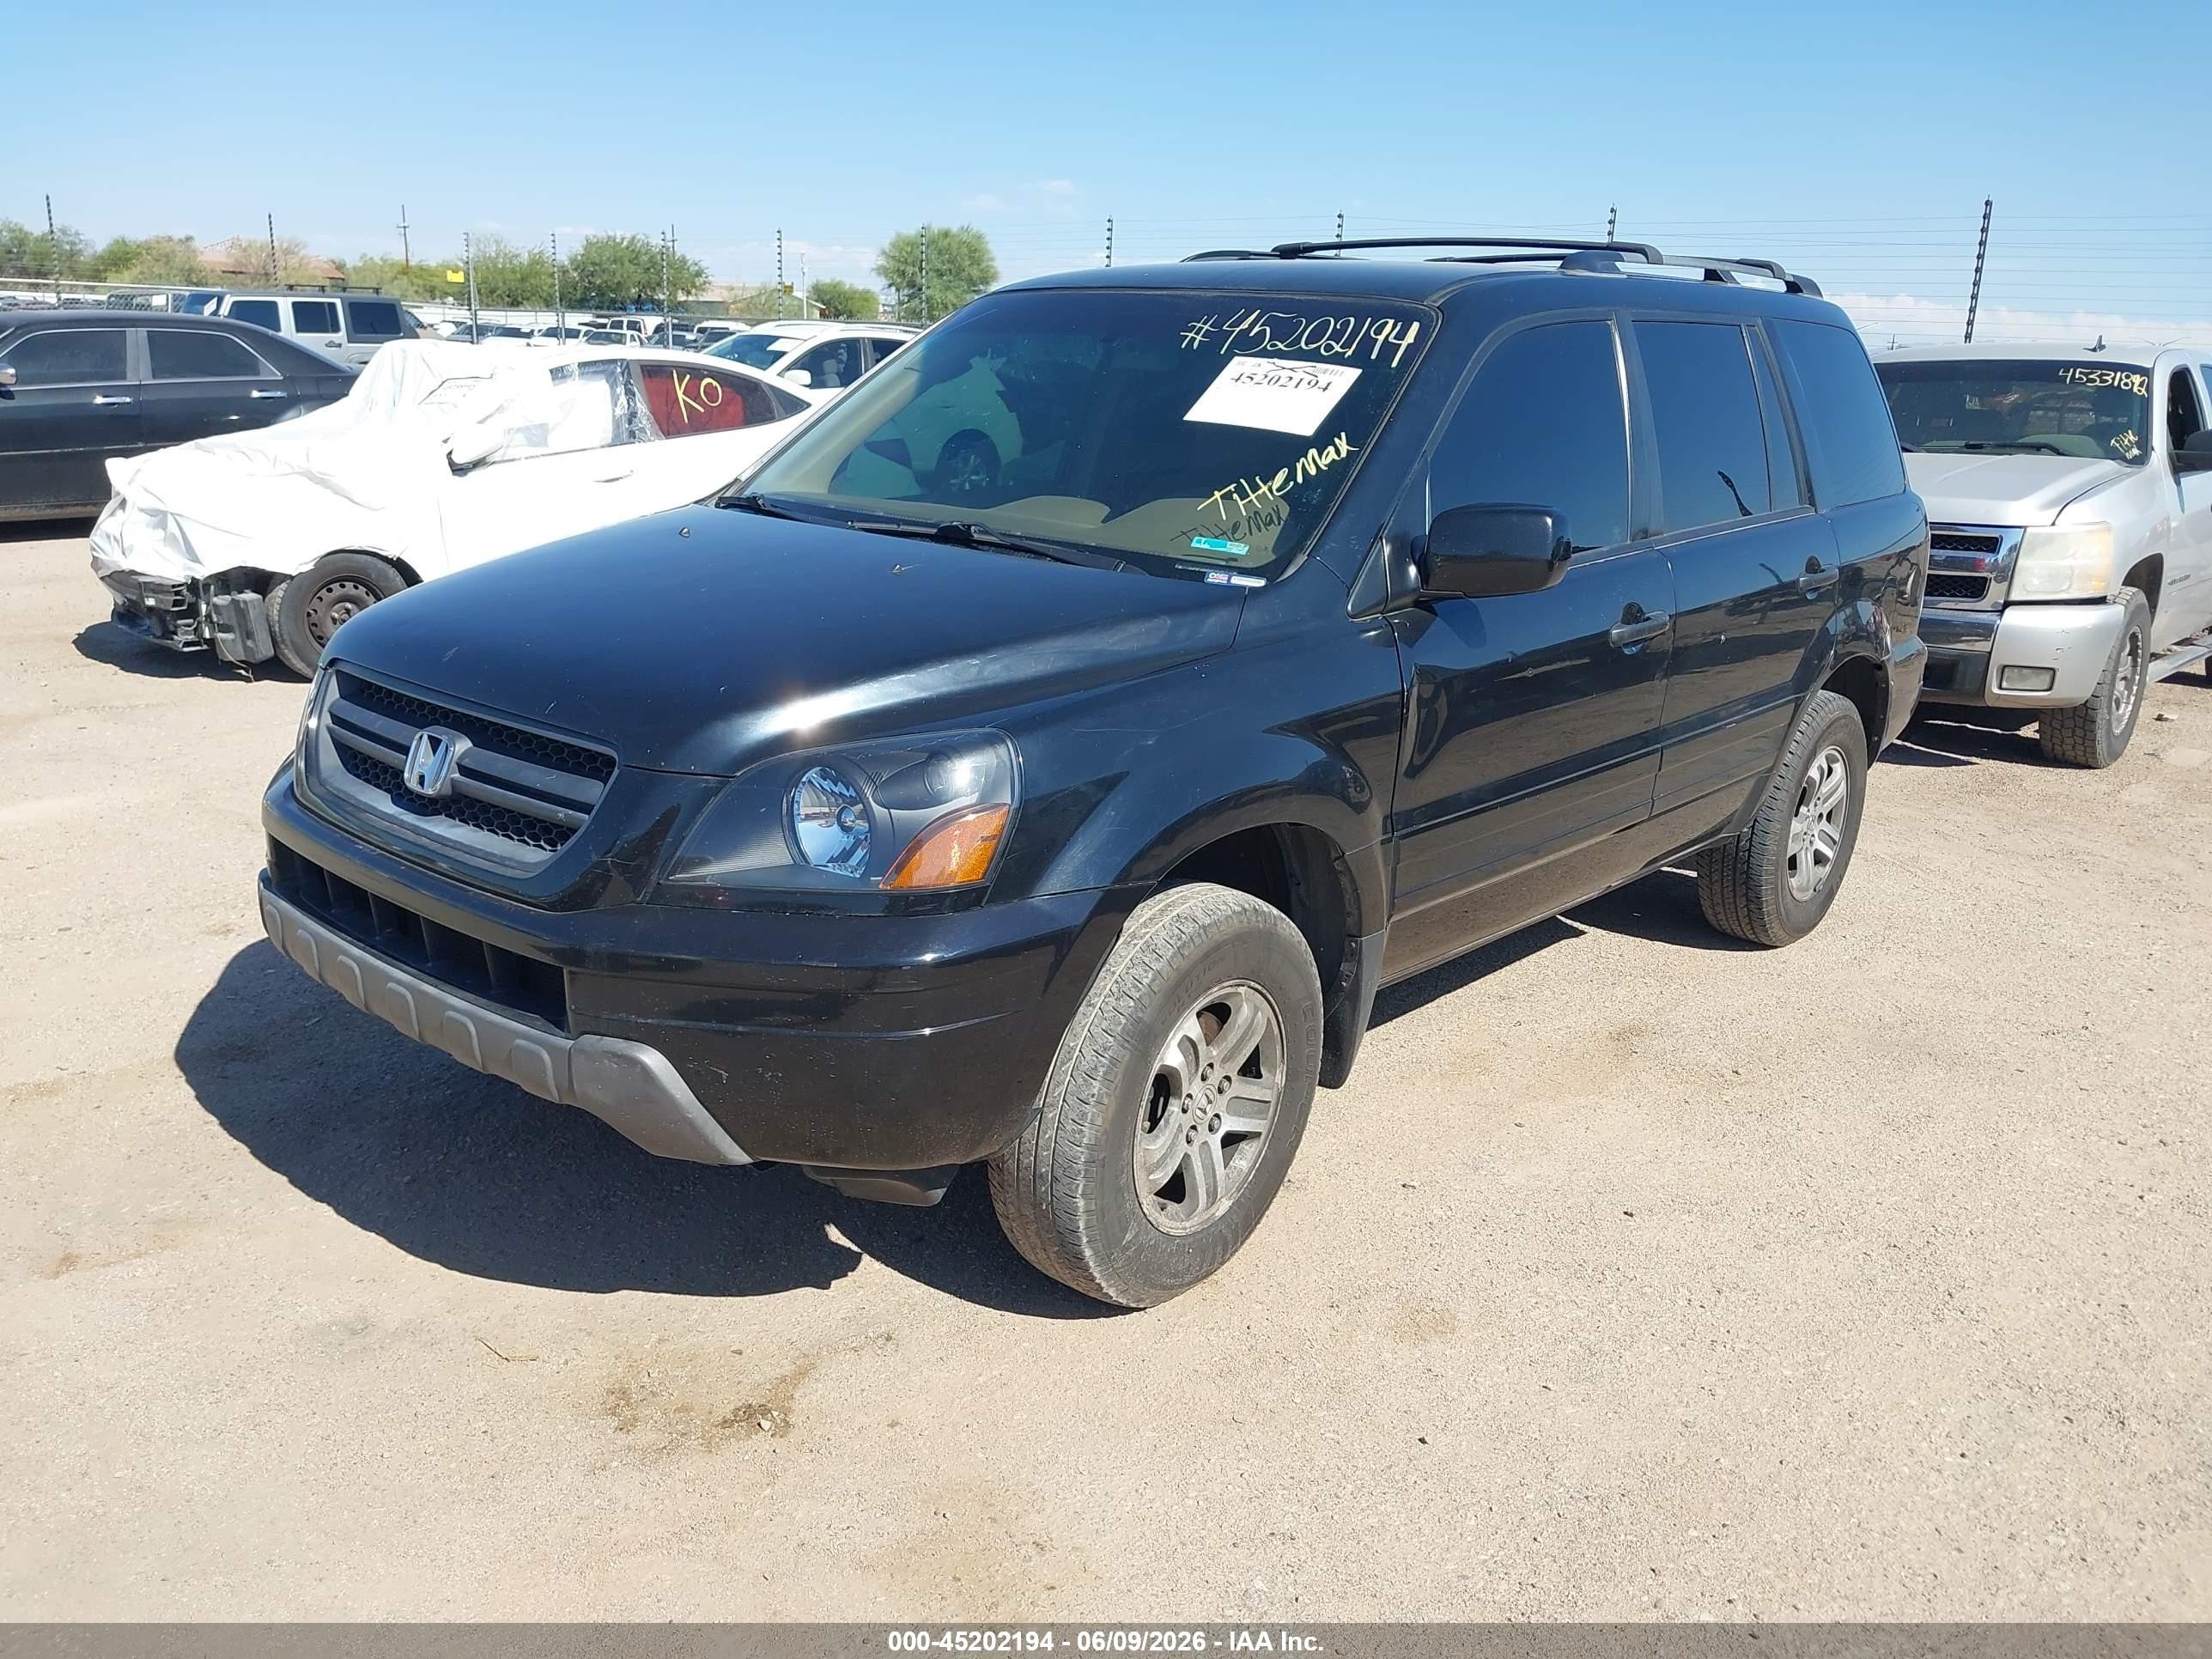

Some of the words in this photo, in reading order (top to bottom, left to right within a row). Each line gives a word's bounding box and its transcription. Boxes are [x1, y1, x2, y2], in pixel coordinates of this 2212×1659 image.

[1179, 308, 1420, 368] #45202194
[672, 369, 722, 423] KO
[1231, 372, 1333, 392] 45202194
[2058, 368, 2148, 398] 45331892
